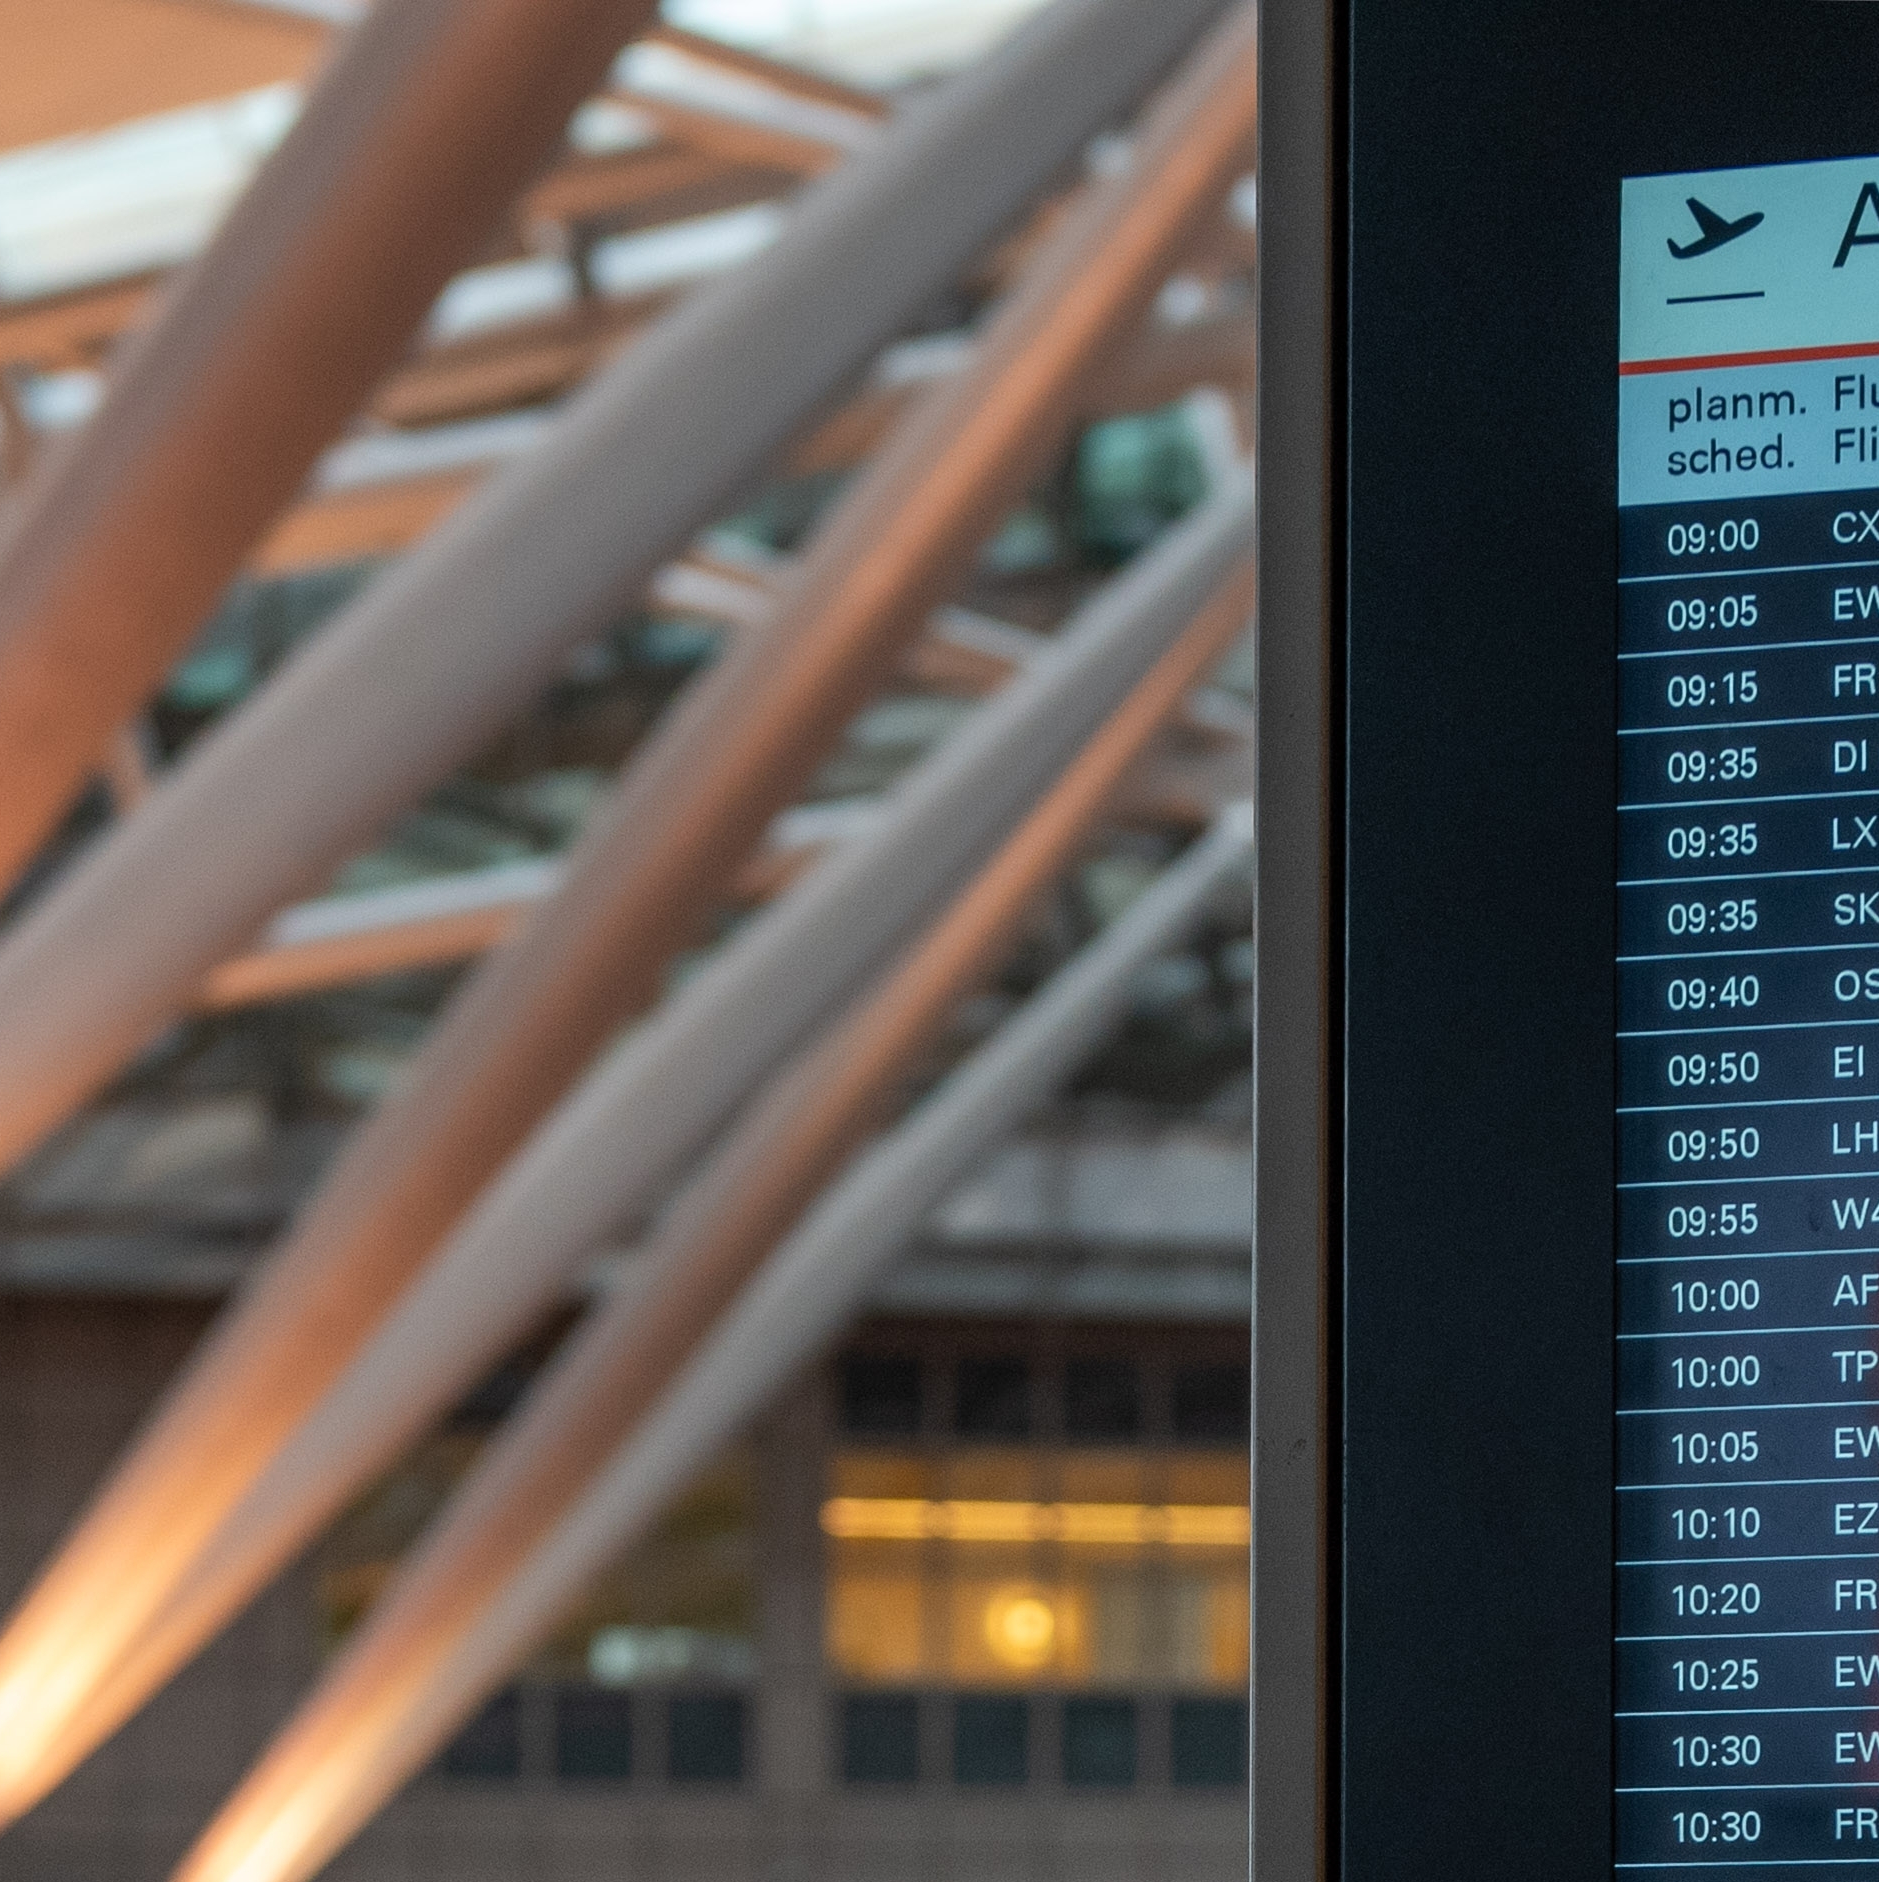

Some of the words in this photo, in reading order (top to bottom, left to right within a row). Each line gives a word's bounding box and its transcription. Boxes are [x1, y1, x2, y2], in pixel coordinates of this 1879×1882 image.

[1668, 386, 1810, 434] planm.
[1667, 433, 1797, 477] sched.
[1666, 517, 1760, 557] 09:00
[1666, 669, 1759, 709] 09:15
[1833, 661, 1877, 698] FR
[1666, 745, 1759, 785] 09:35
[1832, 738, 1868, 775] DI
[1666, 897, 1759, 936] 09:35
[1666, 974, 1760, 1012] 09:40
[1667, 1126, 1761, 1163] 09:50
[1831, 1120, 1879, 1155] LH
[1667, 1202, 1759, 1239] 09:55
[1671, 1354, 1761, 1390] 10:00
[1831, 1349, 1879, 1383] TP
[1671, 1506, 1761, 1541] 10:10
[1671, 1582, 1761, 1617] 10:20
[1834, 1578, 1878, 1612] FR
[1671, 1657, 1760, 1693] 10:25
[1671, 1809, 1762, 1844] 10:30
[1834, 1807, 1879, 1841] FR
